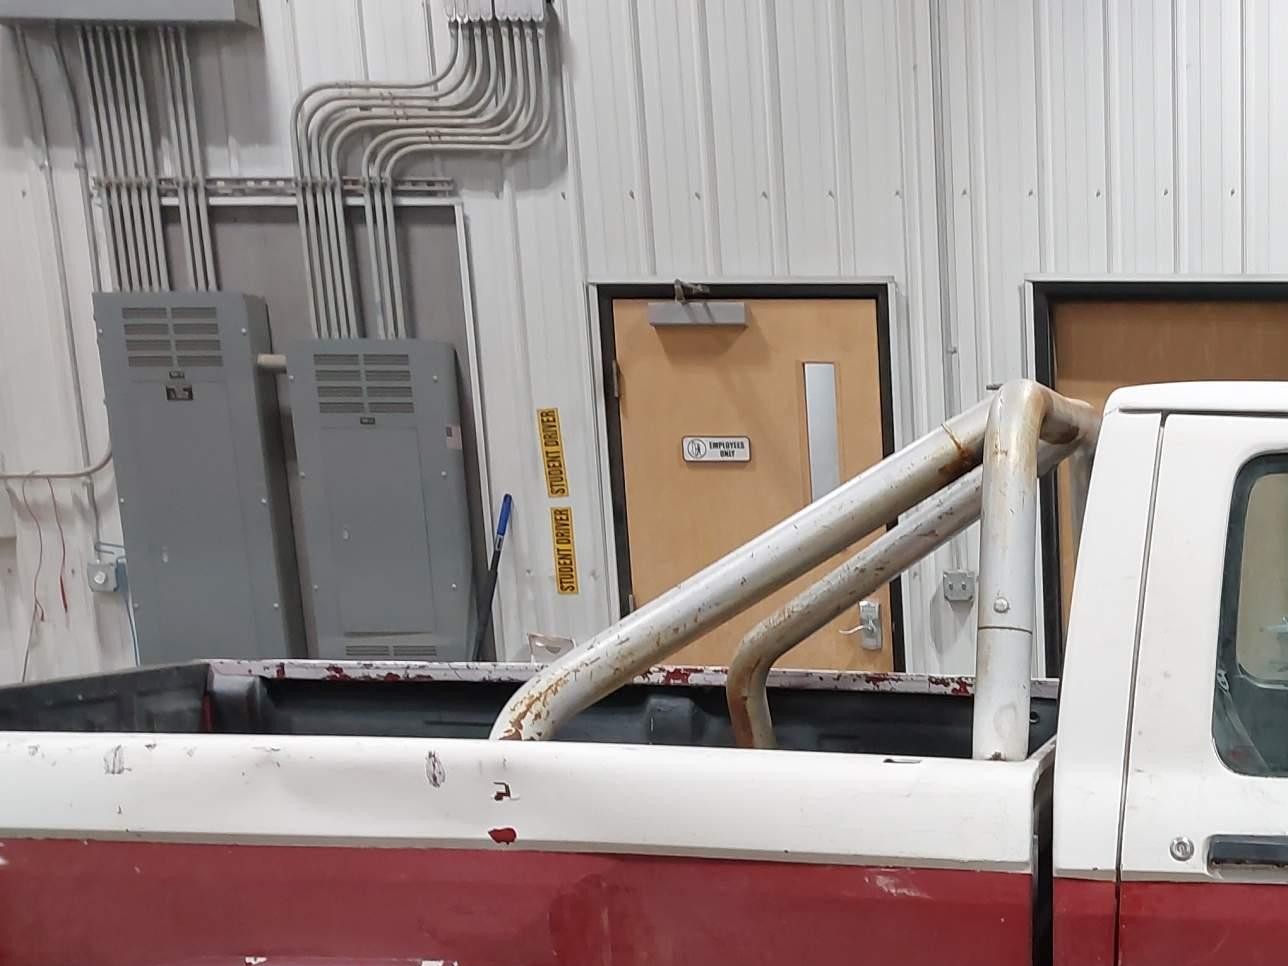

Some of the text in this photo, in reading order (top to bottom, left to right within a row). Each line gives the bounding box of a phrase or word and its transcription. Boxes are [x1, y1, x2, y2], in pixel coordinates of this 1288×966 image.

[541, 410, 566, 495] STUDENT DRIVER
[709, 441, 745, 450] EMPLOYEES
[719, 450, 736, 458] ONLY
[553, 508, 575, 592] STUDENT DRIVER
